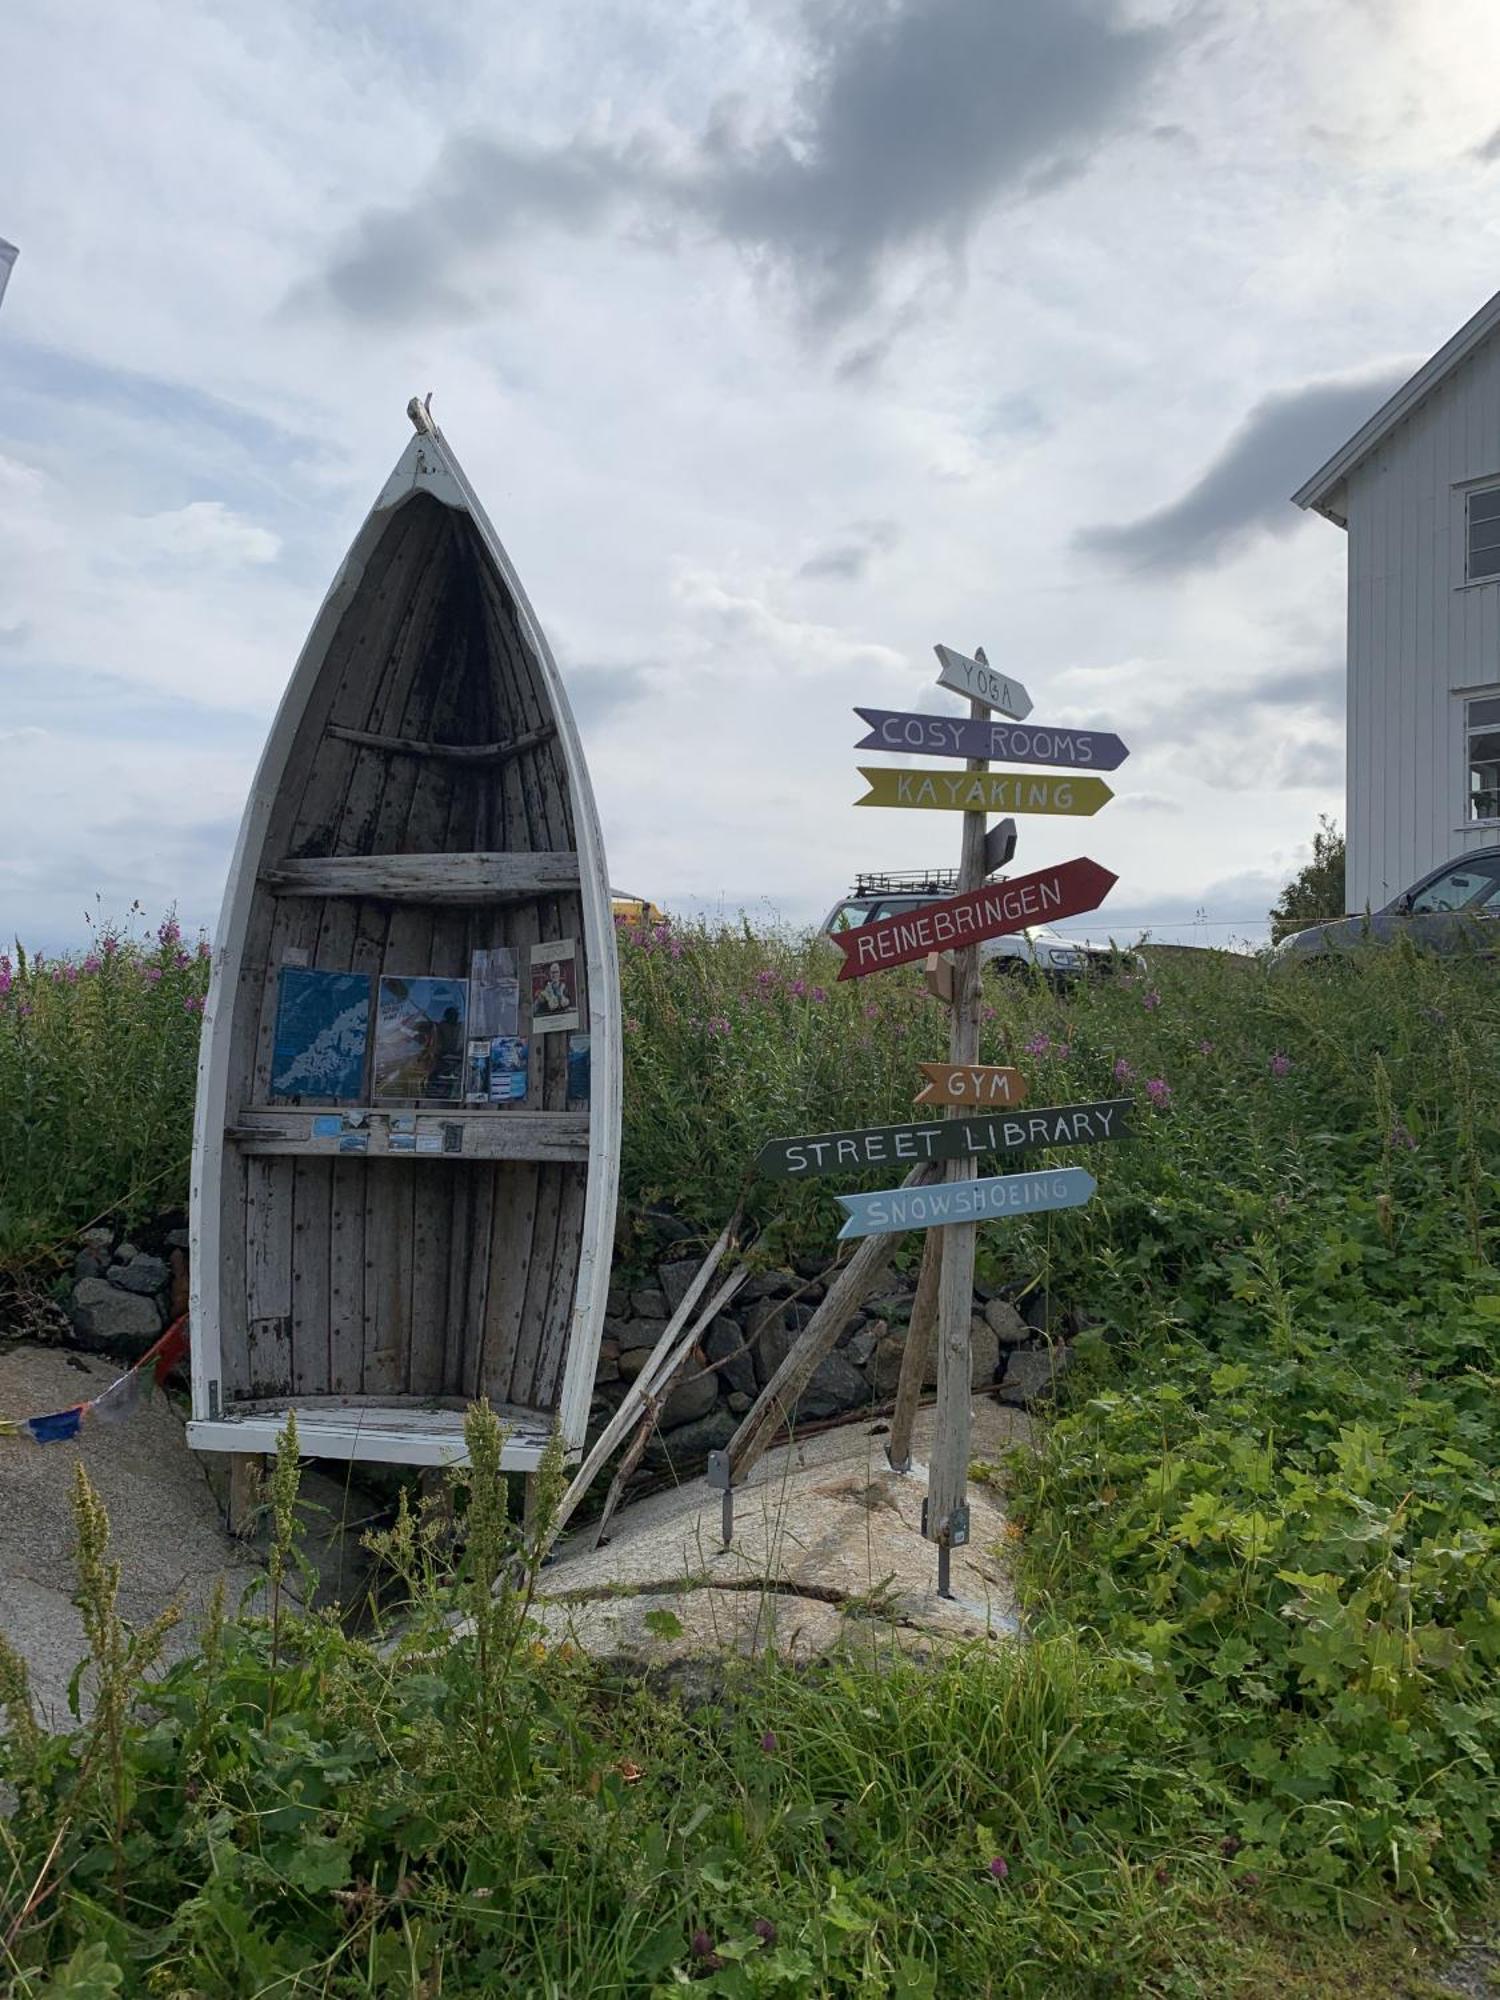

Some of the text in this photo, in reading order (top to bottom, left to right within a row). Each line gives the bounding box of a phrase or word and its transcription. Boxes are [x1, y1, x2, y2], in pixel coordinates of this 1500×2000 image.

[962, 664, 1013, 708] YOGA
[881, 717, 1093, 762] COSY ROOMS
[897, 774, 1074, 808] KAYAKING
[858, 878, 1062, 965] REINEBRINGEN
[948, 1072, 1010, 1100] GYM
[785, 1109, 1114, 1172] STREET LIBRARY
[866, 1178, 1068, 1226] SNOWSHOEING
